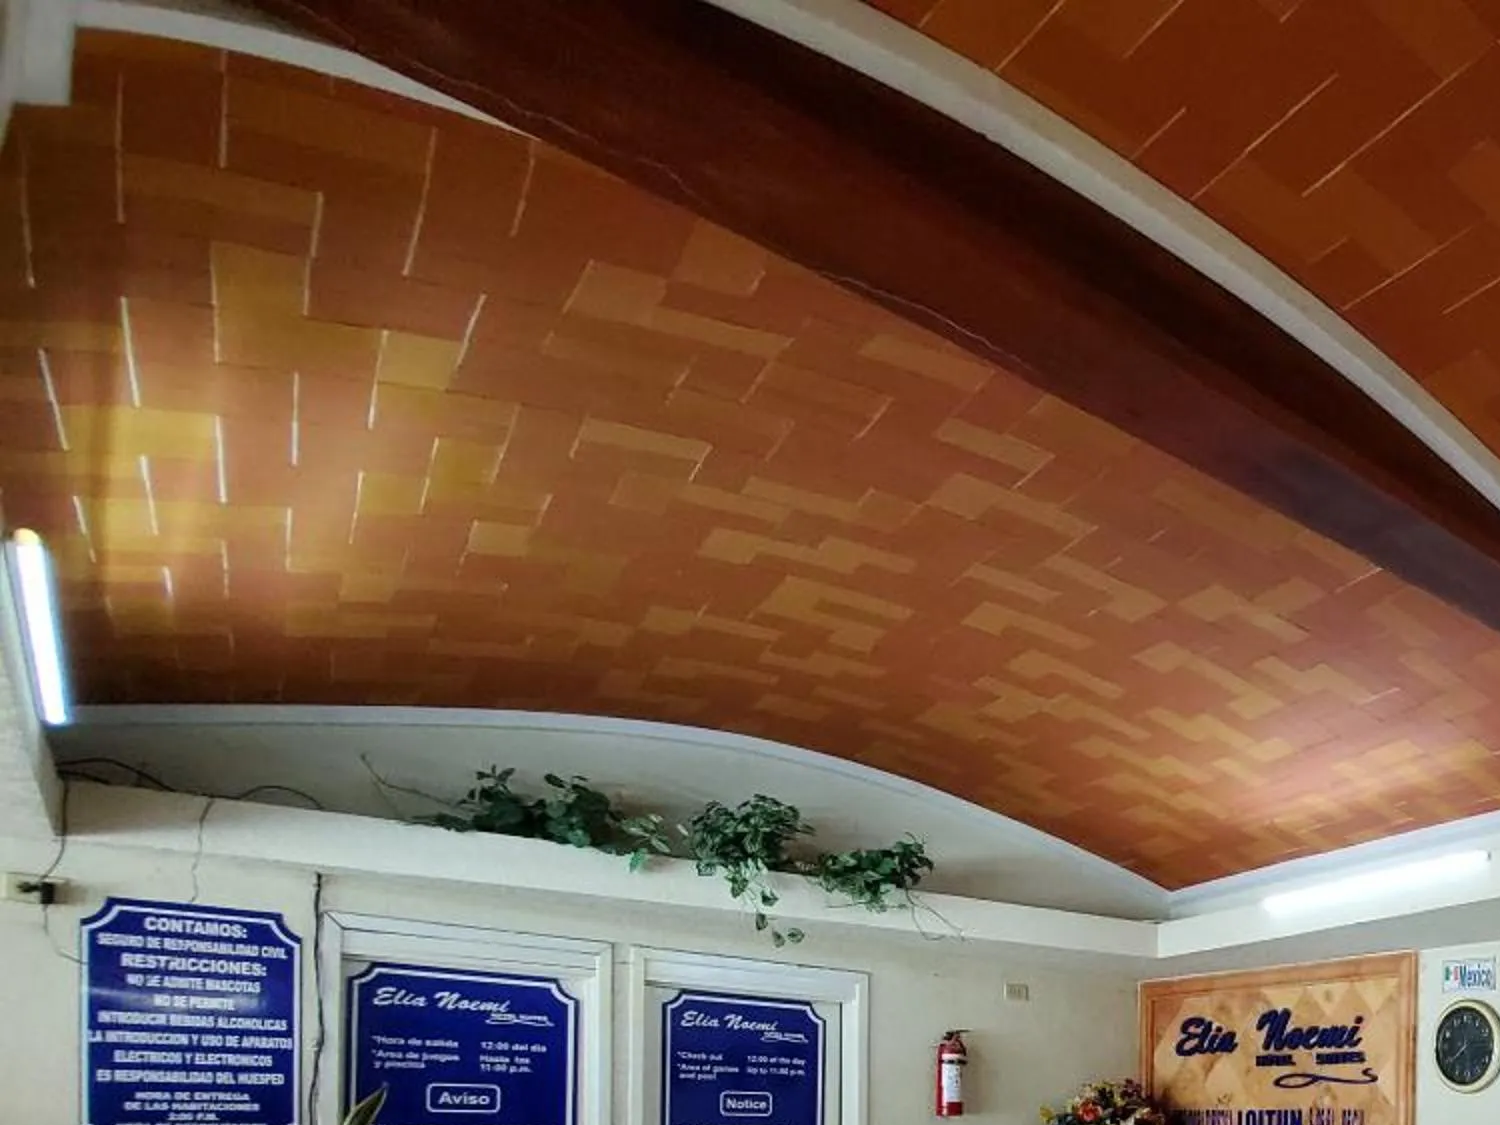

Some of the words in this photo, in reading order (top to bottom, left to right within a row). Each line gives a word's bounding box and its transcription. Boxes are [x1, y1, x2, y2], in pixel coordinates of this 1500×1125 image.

[144, 917, 248, 938] CONTAMOS:
[147, 936, 161, 949] DE
[163, 937, 259, 957] RESPONSABILIDAD
[261, 946, 288, 959] CIVIL
[121, 953, 267, 976] RESTRICCIONES:
[126, 974, 144, 986] NO
[206, 979, 260, 993] MASCOTAS
[153, 994, 170, 1007] NO
[174, 995, 188, 1008] SE
[373, 987, 428, 1007] Elia
[434, 991, 510, 1013] Noemi
[216, 1016, 288, 1030] ALCOHOLICAS
[681, 1011, 720, 1028] Elia
[724, 1014, 779, 1031] Noemi
[1175, 1016, 1238, 1056] Elia
[1256, 1008, 1364, 1051] Noemi
[192, 1035, 198, 1046] Y
[201, 1035, 223, 1047] USO
[226, 1036, 240, 1047] DE
[242, 1037, 293, 1049] APARATOS
[195, 1053, 272, 1066] ELECTRONICOS
[114, 1070, 213, 1083] RESPONSABILIDAD
[216, 1072, 235, 1084] DEL
[237, 1074, 285, 1085] HUESPED
[438, 1091, 490, 1105] Aviso
[726, 1098, 767, 1109] Notice
